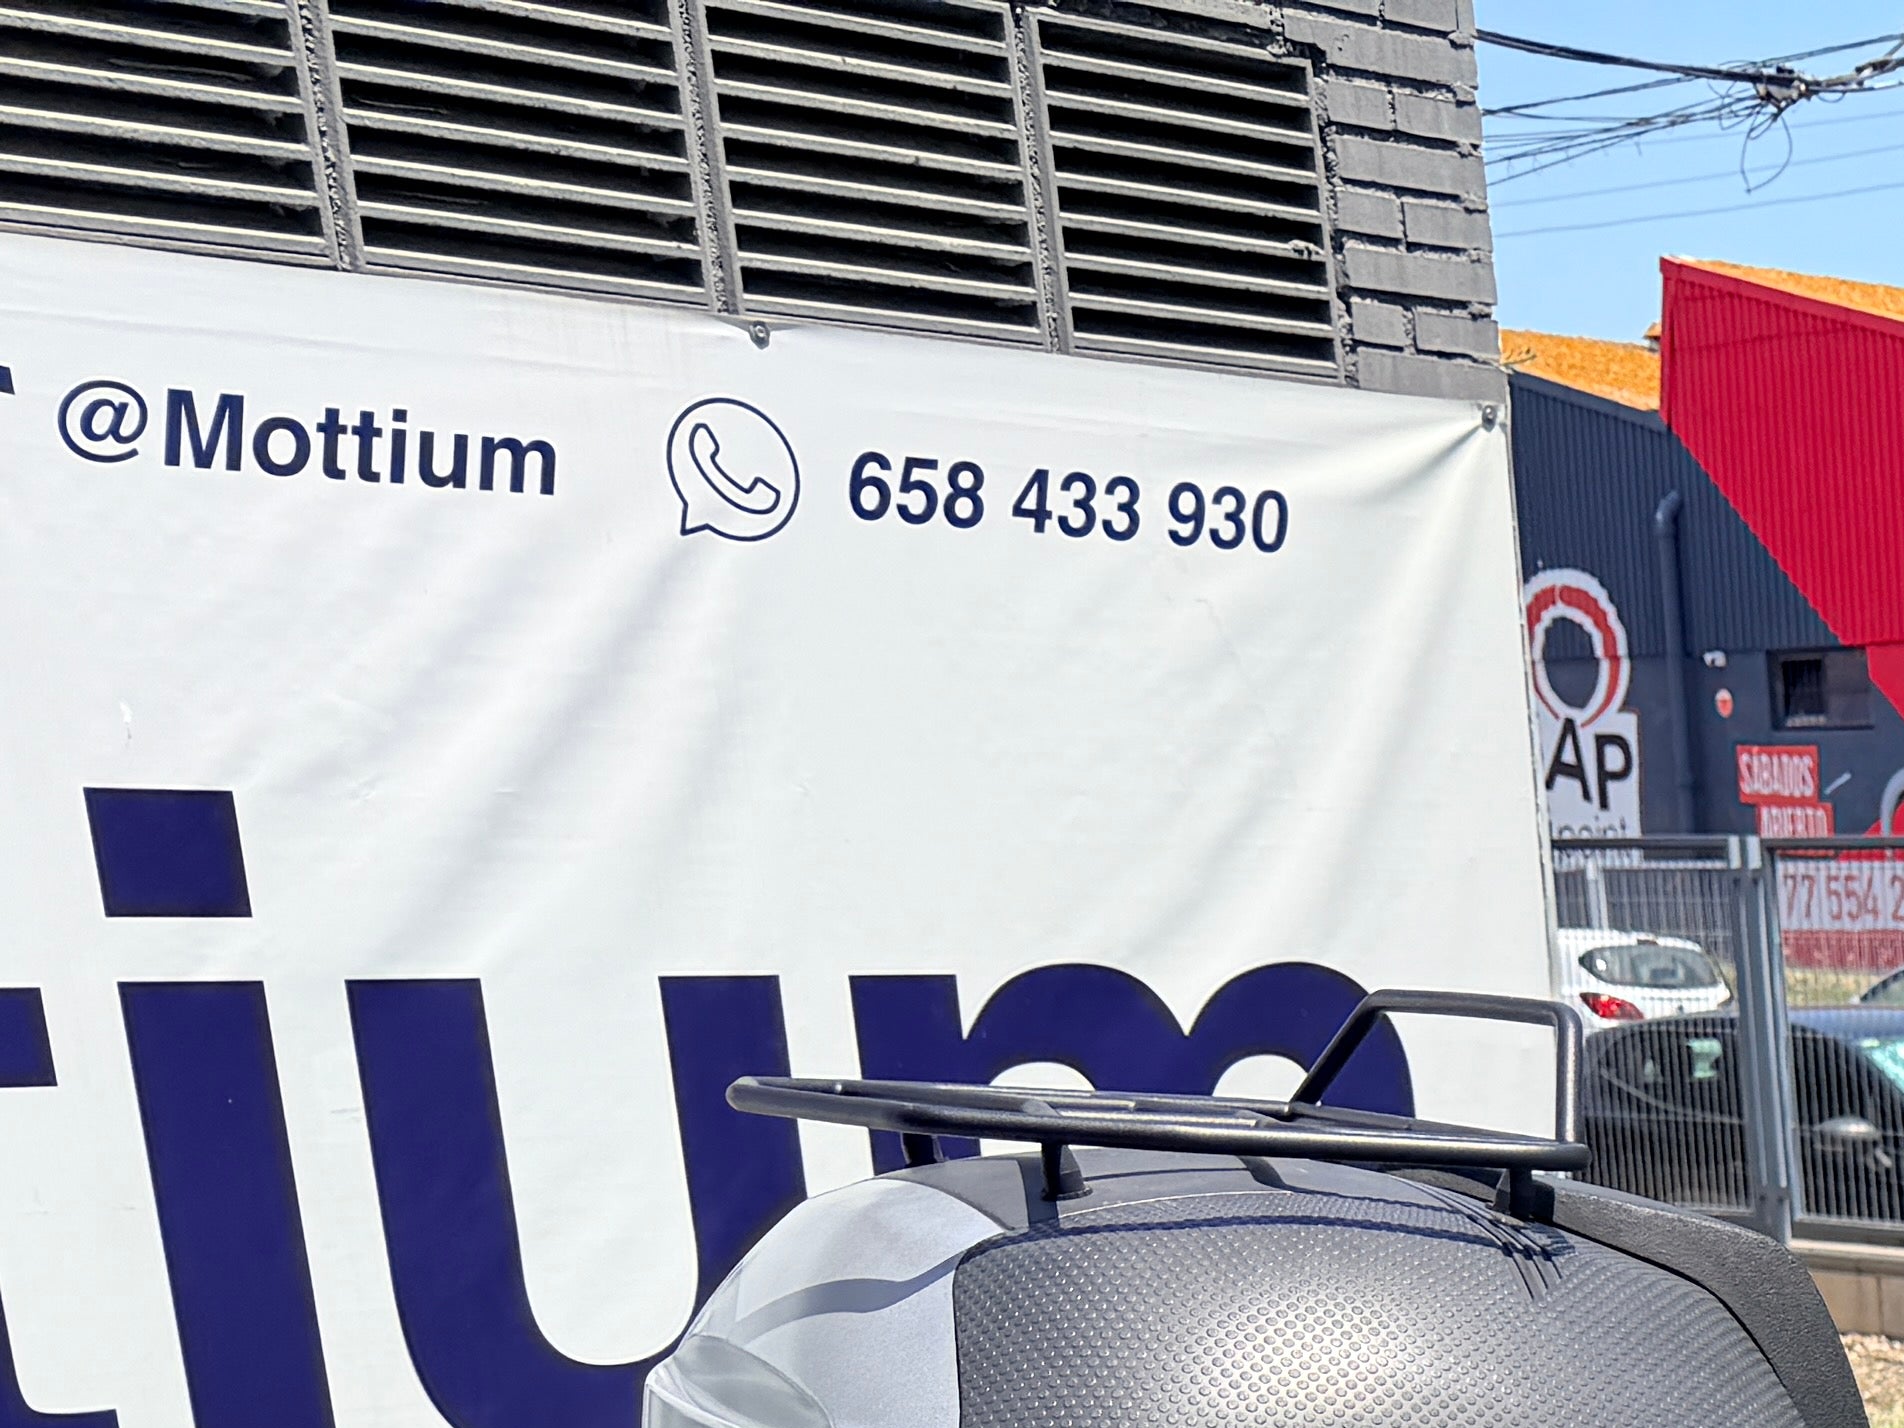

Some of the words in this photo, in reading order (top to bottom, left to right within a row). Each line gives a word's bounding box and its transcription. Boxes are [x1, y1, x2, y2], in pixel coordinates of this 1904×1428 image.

[57, 379, 557, 496] @Mottium
[849, 450, 985, 529] 658
[1011, 468, 1141, 541] 433
[1167, 481, 1289, 554] 930
[1825, 873, 1880, 922] 554
